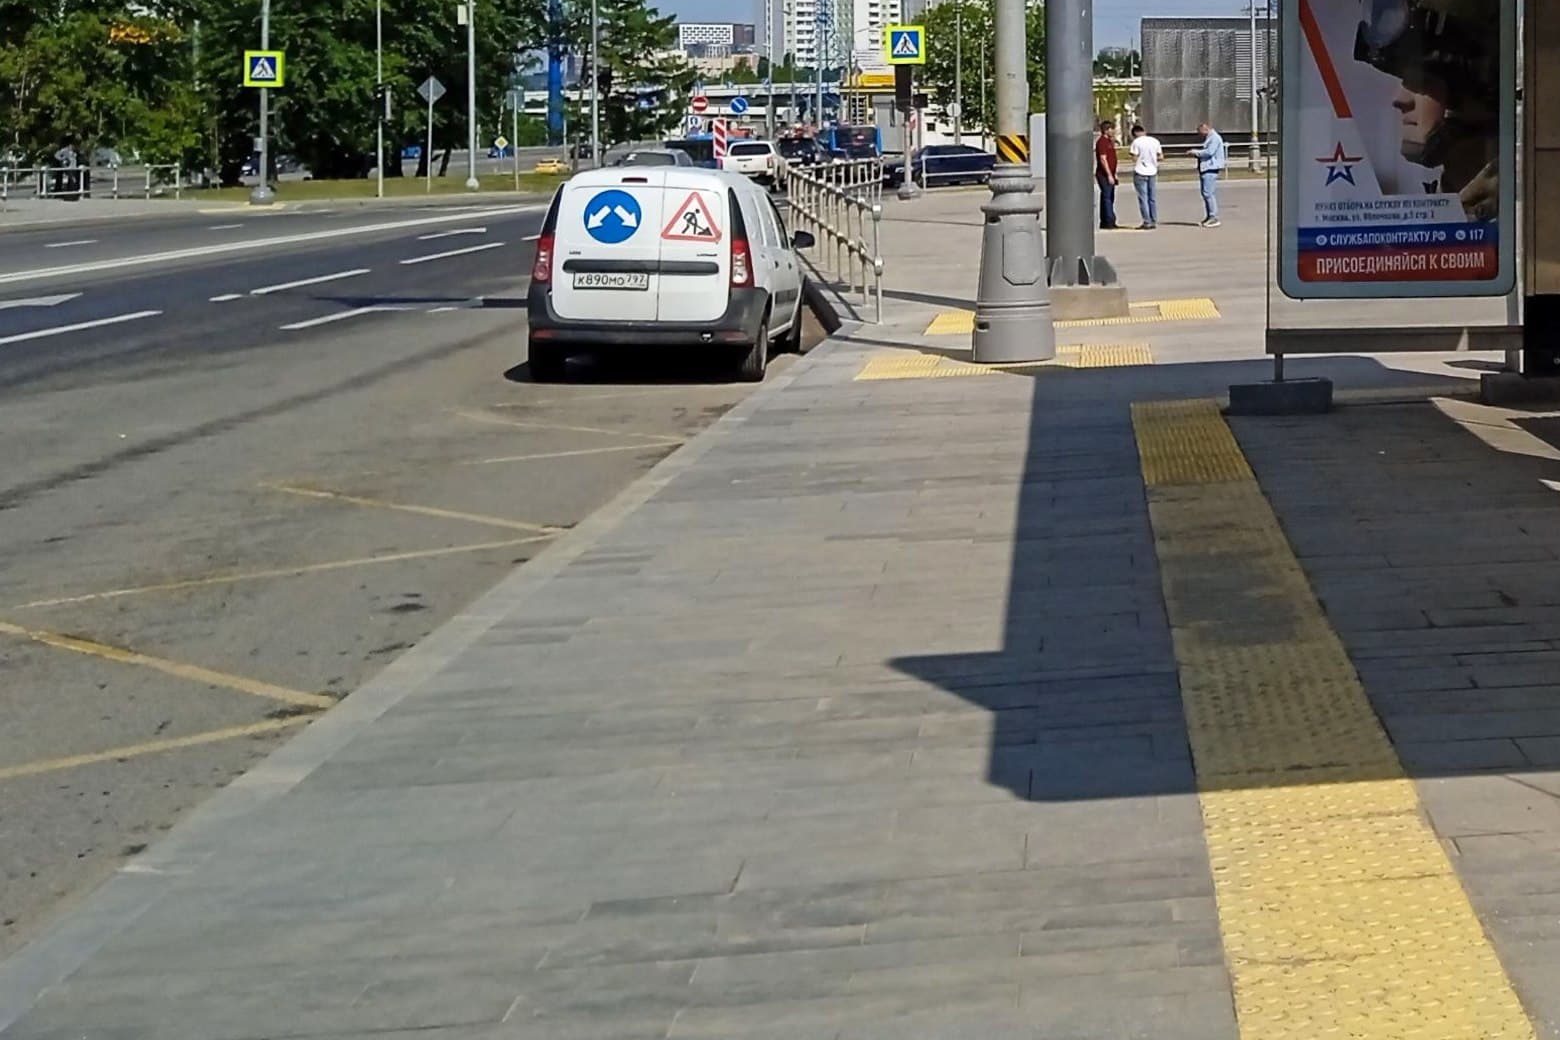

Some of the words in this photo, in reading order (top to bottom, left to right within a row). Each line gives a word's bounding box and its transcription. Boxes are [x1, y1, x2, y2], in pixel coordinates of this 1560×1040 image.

[1329, 230, 1447, 246] СЛУЖБАПОКОНТРАКТУ.РФ
[1469, 229, 1484, 241] 117
[1316, 252, 1427, 275] ПРИСОЕДИНЯЙСЯ
[1429, 254, 1438, 270] К
[1440, 251, 1485, 269] СВОИМ
